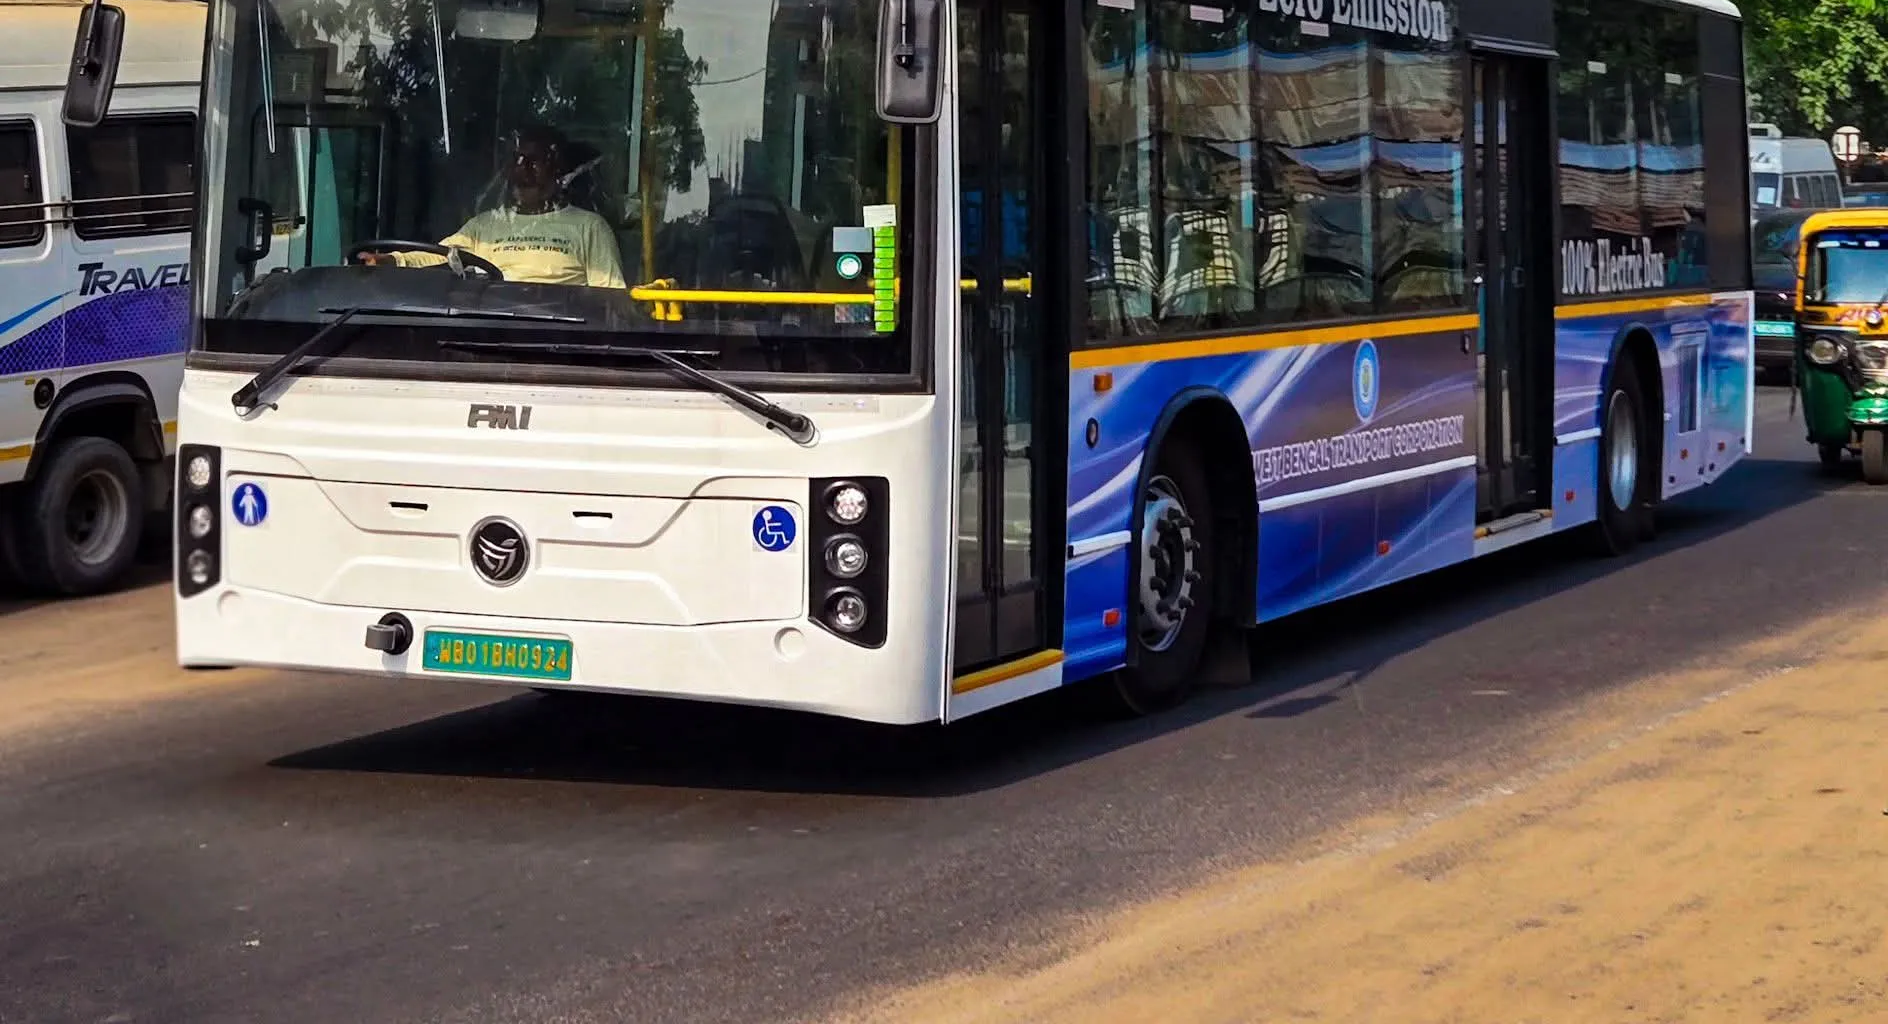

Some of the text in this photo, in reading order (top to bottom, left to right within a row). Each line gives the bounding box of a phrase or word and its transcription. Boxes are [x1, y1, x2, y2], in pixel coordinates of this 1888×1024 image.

[1561, 239, 1595, 294] 100%
[1597, 237, 1642, 292] Electric
[1283, 439, 1330, 478] BENGAL
[1330, 427, 1392, 469] TRANSPORT
[1393, 415, 1464, 456] CORPORATION
